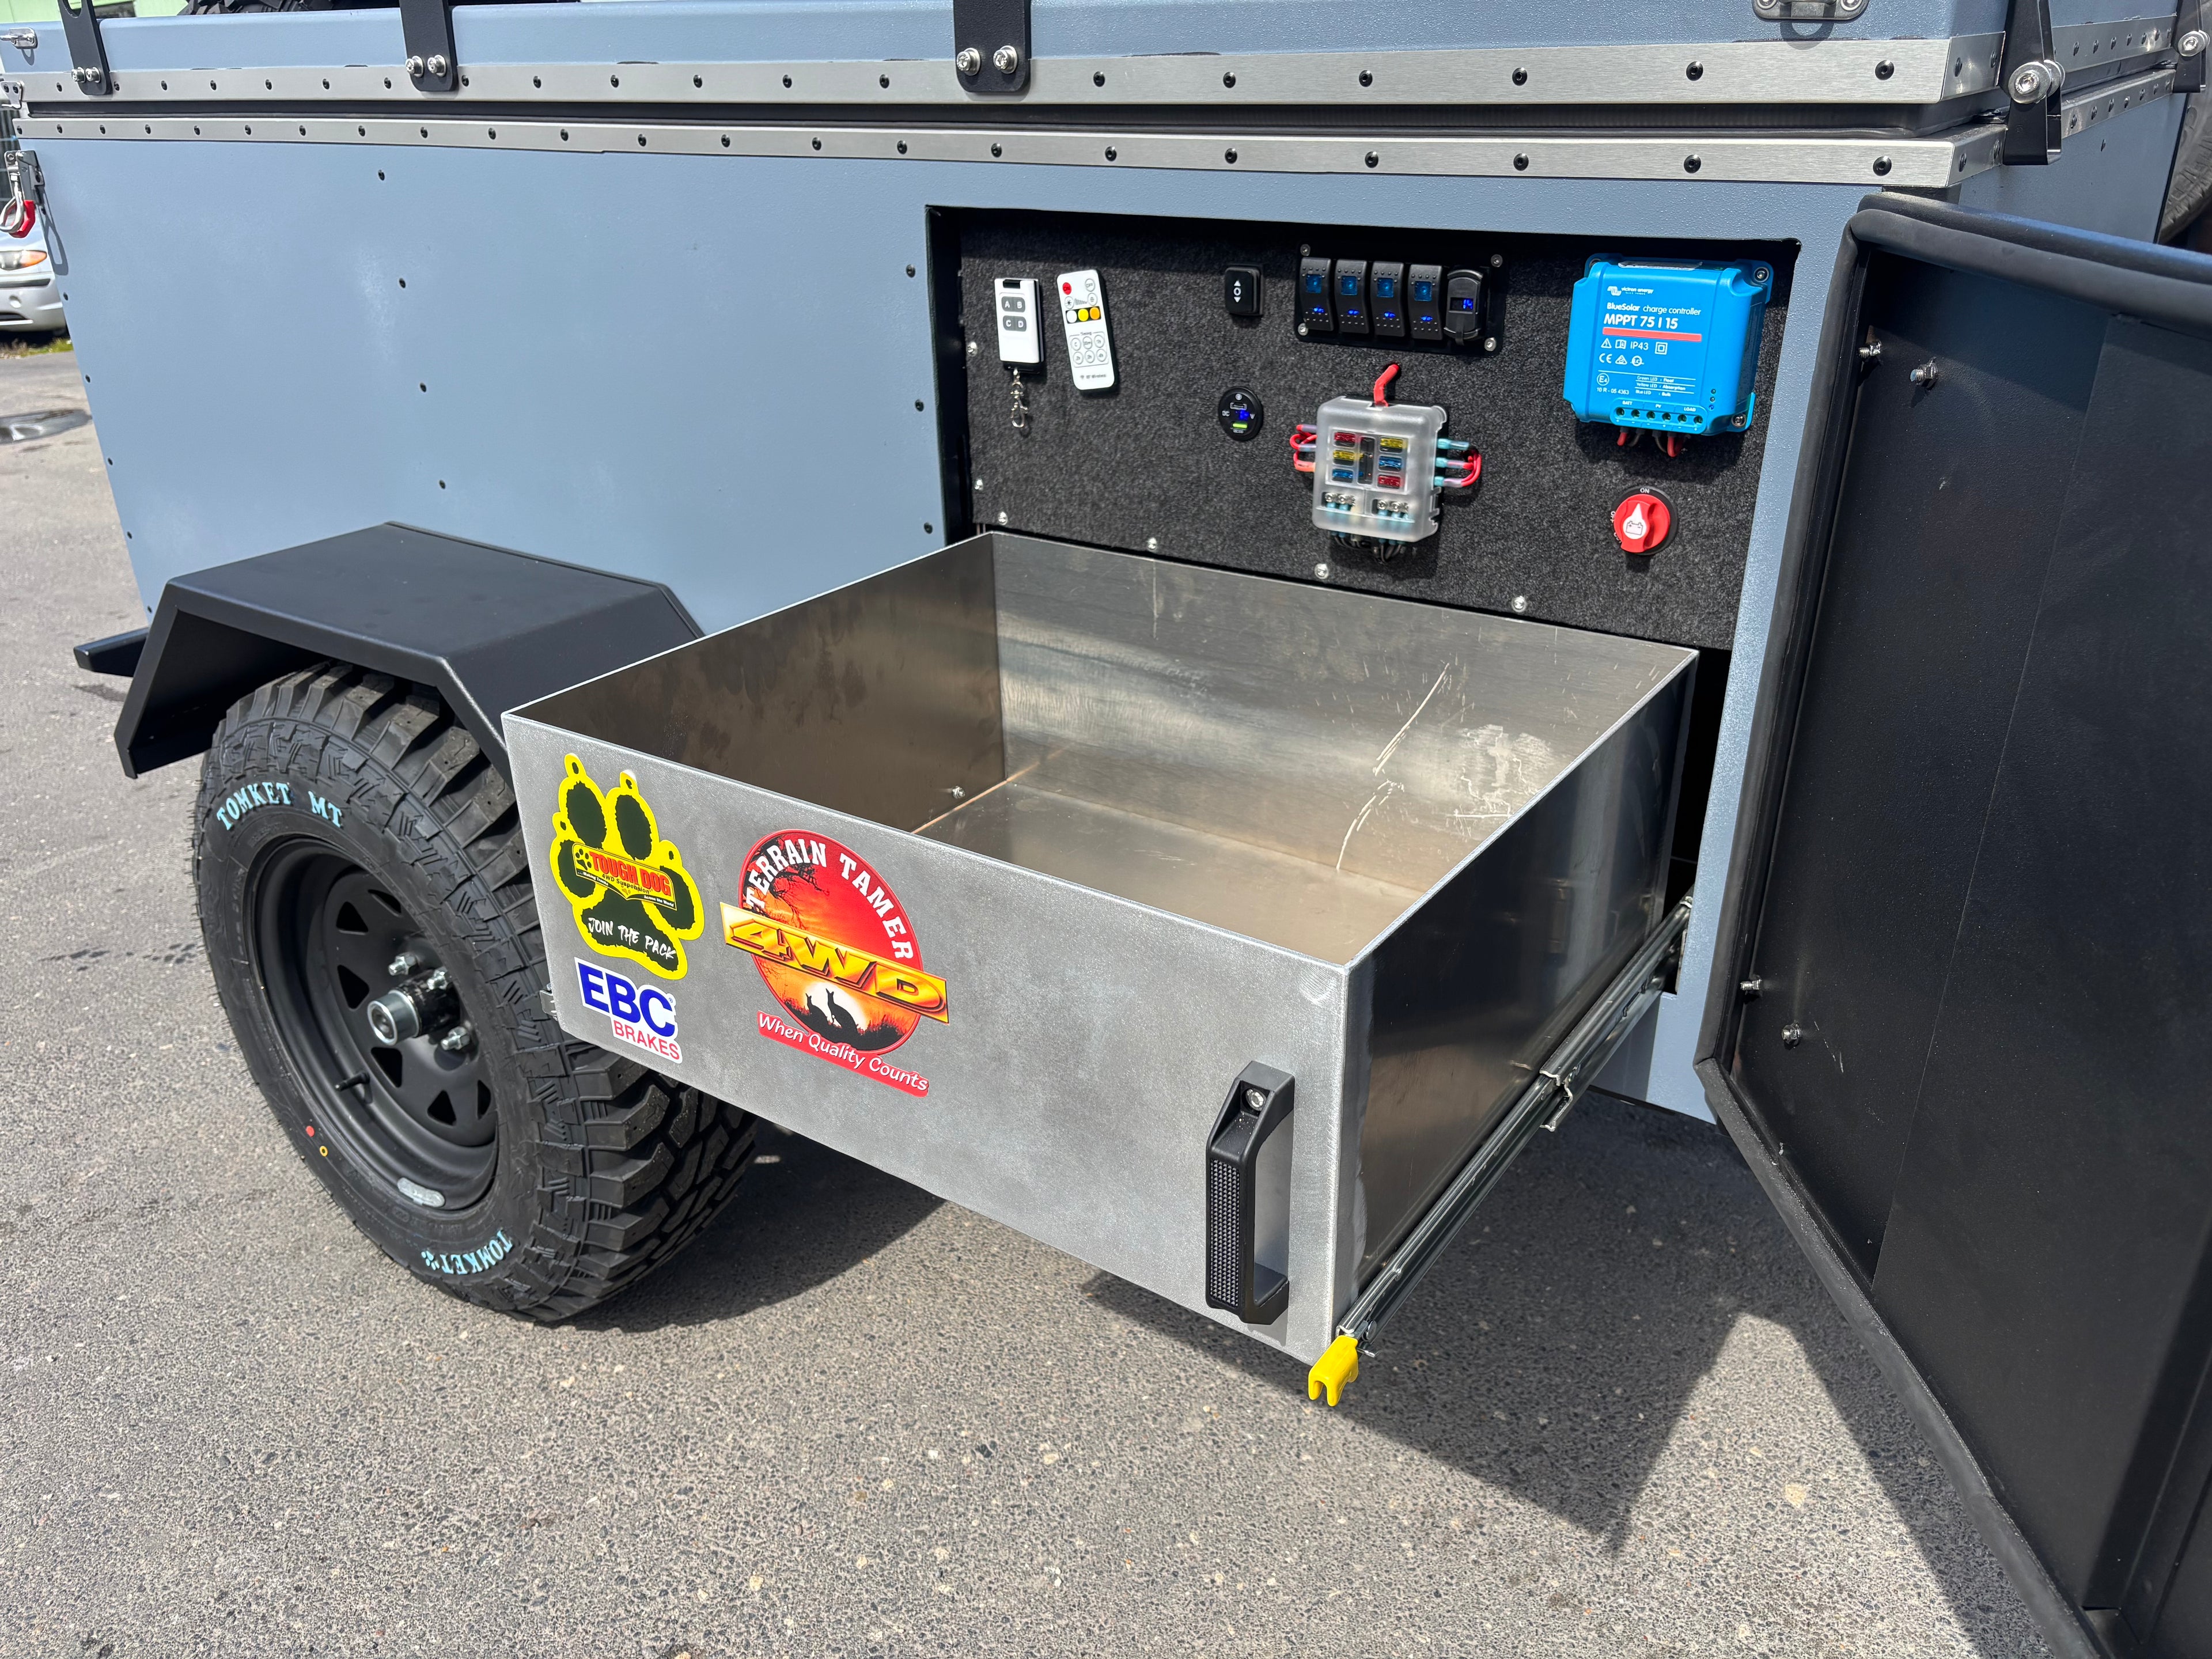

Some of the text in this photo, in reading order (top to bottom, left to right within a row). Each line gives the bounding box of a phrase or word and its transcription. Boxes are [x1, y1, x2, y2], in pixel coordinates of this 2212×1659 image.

[1604, 313, 1638, 327] MPPT
[1640, 316, 1655, 328] 75
[1666, 317, 1679, 329] 15
[1607, 302, 1701, 316] BlueSolar charge controller
[1630, 341, 1649, 350] IP43
[217, 782, 342, 830] TOMKET MT
[589, 851, 672, 896] TOUGH DOG
[602, 874, 650, 894] 4WD Suspension
[747, 838, 914, 959] TERRAIN TAMER
[588, 918, 676, 960] JOIN THE PACK
[730, 919, 946, 1013] 4WD
[577, 962, 676, 1036] EBC
[613, 1020, 680, 1060] BRAKES
[759, 1013, 928, 1092] When Quality Counts
[436, 1229, 514, 1275] TOMKET
